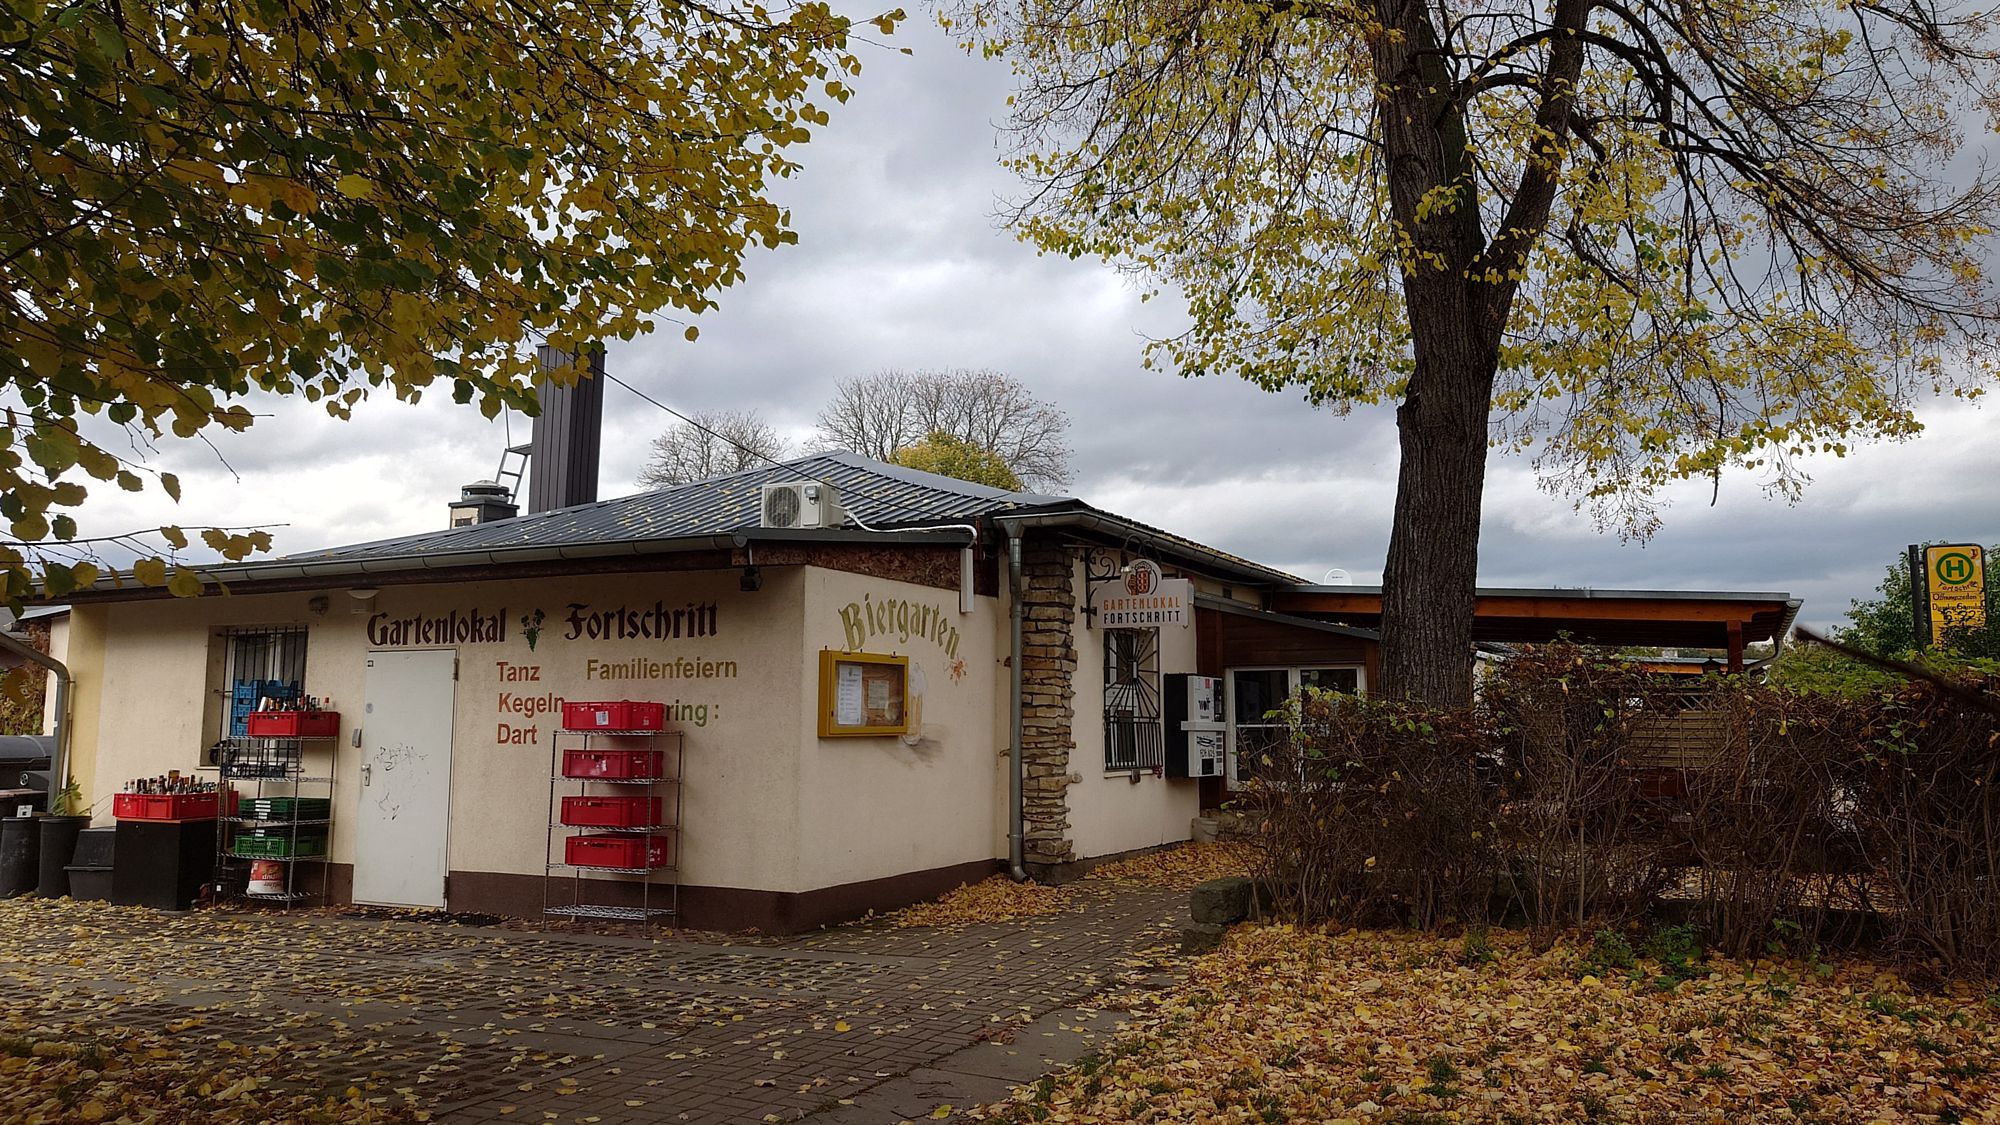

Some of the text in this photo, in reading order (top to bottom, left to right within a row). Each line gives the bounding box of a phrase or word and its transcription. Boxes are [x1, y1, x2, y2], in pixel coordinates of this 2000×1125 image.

[1946, 560, 1964, 577] H
[1103, 597, 1180, 611] GARTENLOKAL
[367, 600, 718, 646] Gartenlokal Fortschritt
[838, 593, 960, 659] Biergarten
[1103, 611, 1180, 625] FORTSCHRITT
[497, 656, 737, 682] Tanz Familienfeiern
[498, 692, 564, 719] Kegeln
[497, 723, 537, 745] Dart
